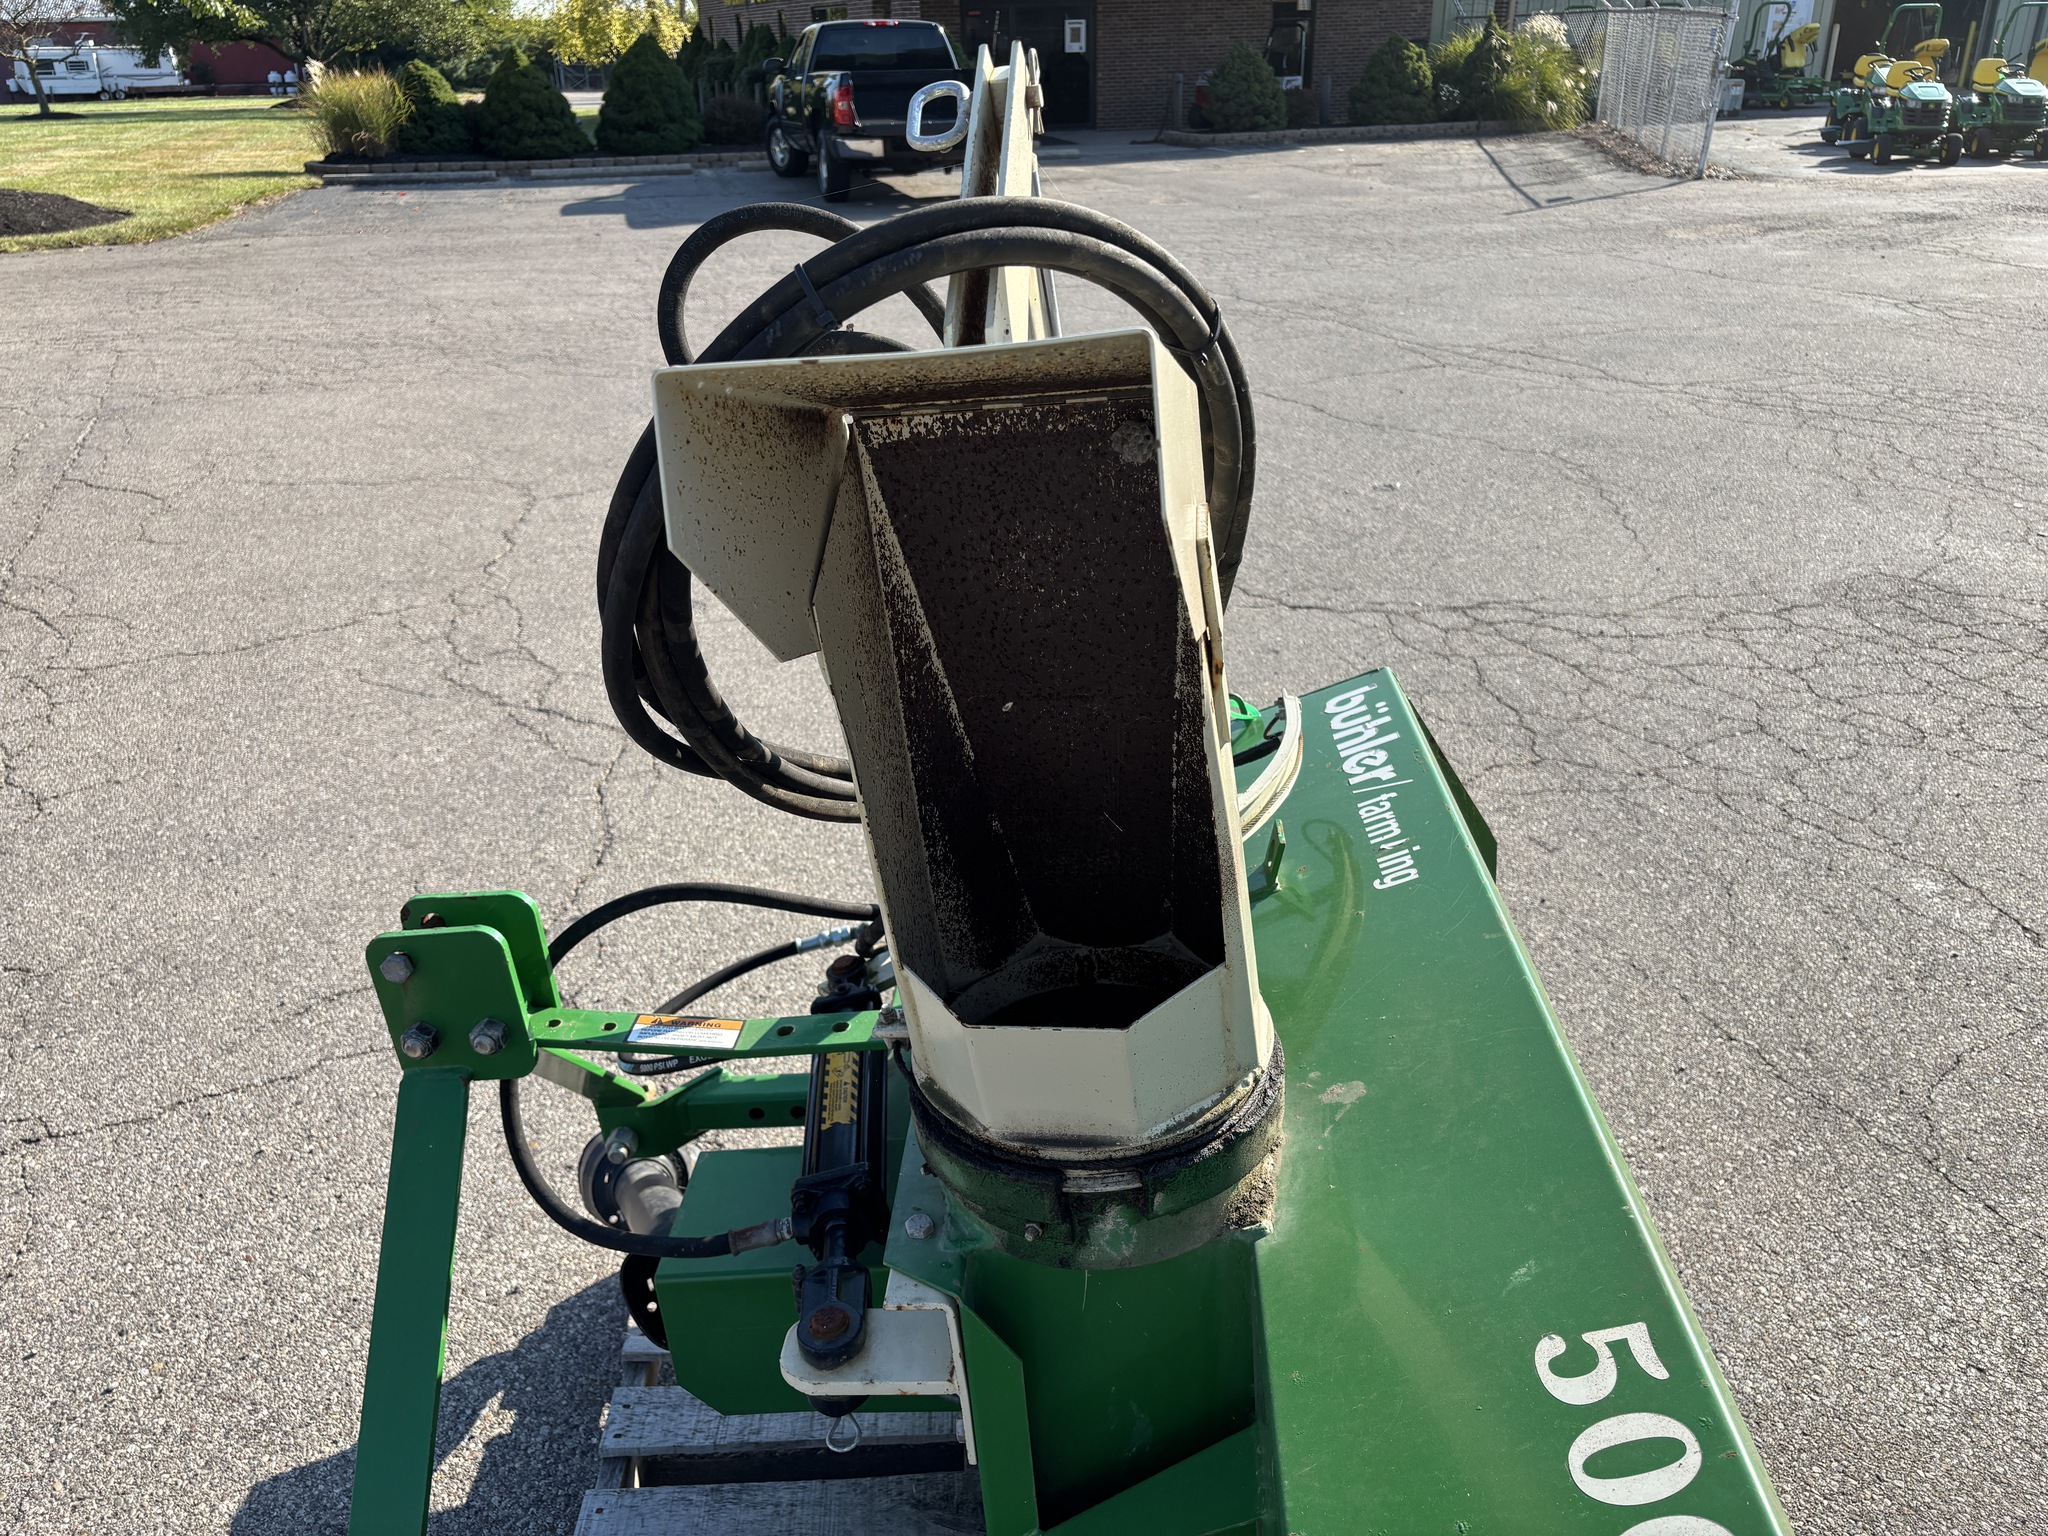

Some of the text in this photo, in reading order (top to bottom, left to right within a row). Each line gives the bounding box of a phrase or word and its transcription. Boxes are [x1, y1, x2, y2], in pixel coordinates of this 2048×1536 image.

[671, 1020, 722, 1028] WARNING
[653, 1062, 666, 1071] PSI
[666, 1059, 679, 1069] WP
[1534, 1321, 1738, 1536] 50
